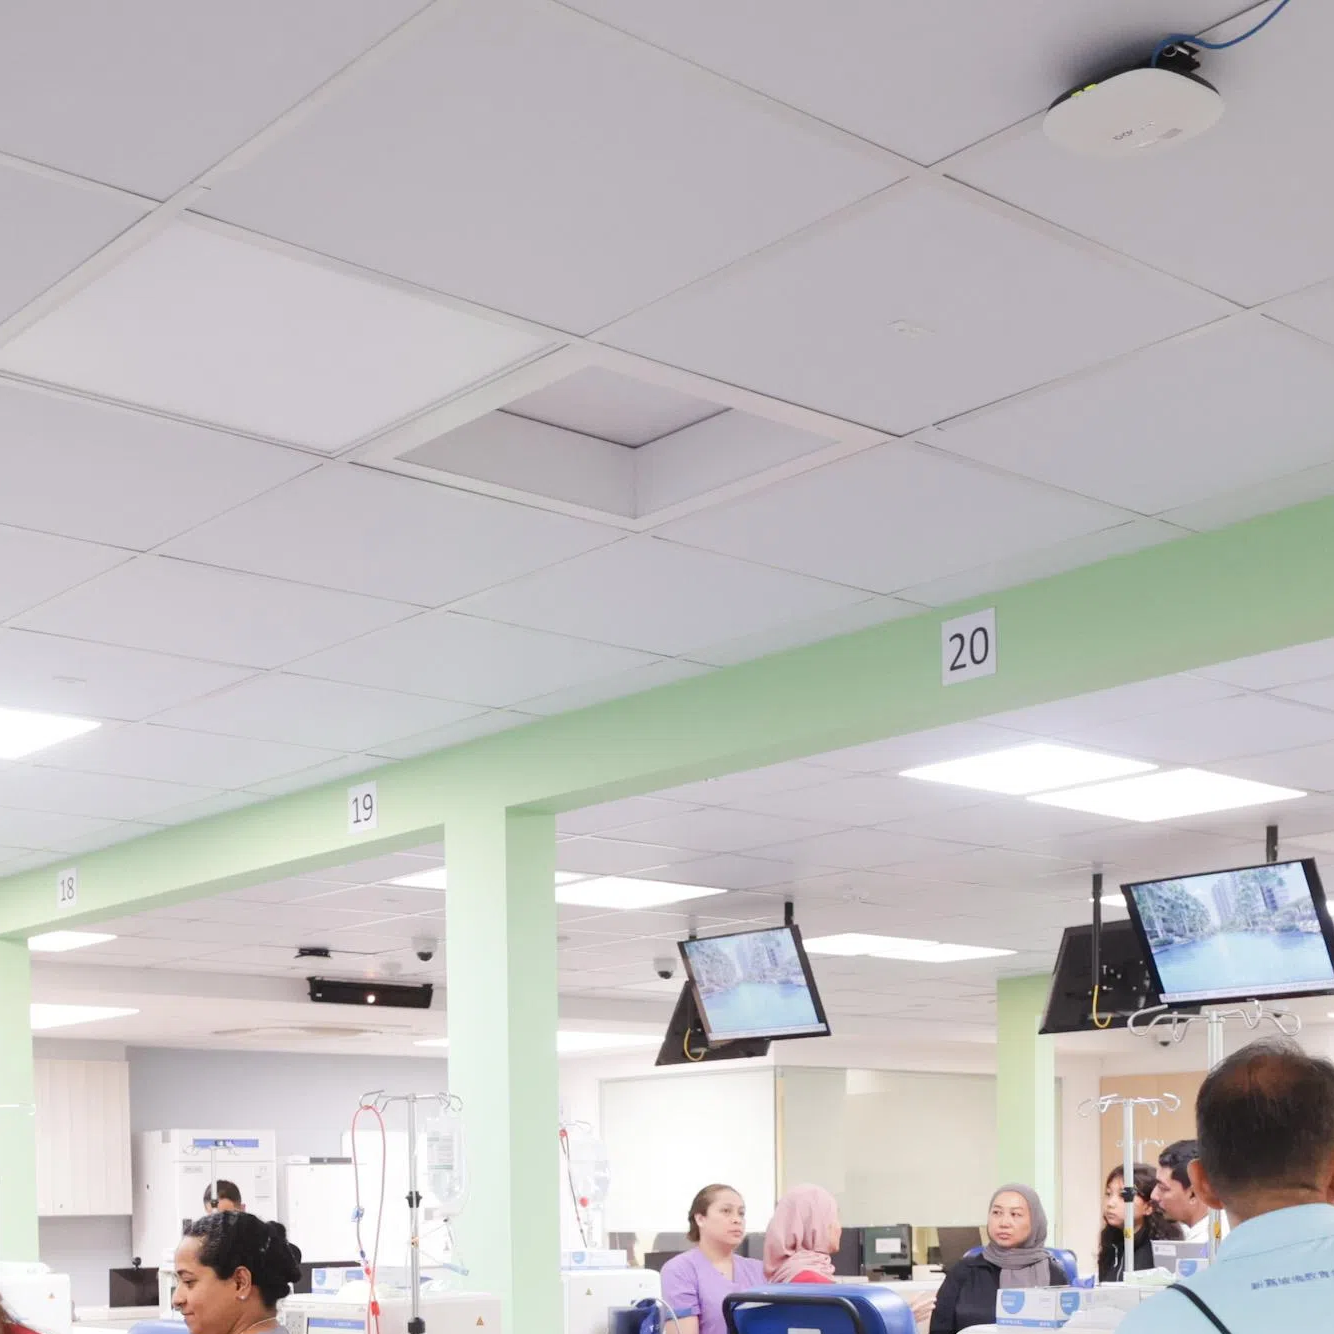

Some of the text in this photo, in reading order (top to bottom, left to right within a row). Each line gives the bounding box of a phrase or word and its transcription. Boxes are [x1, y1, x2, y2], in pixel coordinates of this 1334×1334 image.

[949, 627, 989, 671] 20
[352, 793, 373, 824] 19
[60, 876, 75, 901] 18
